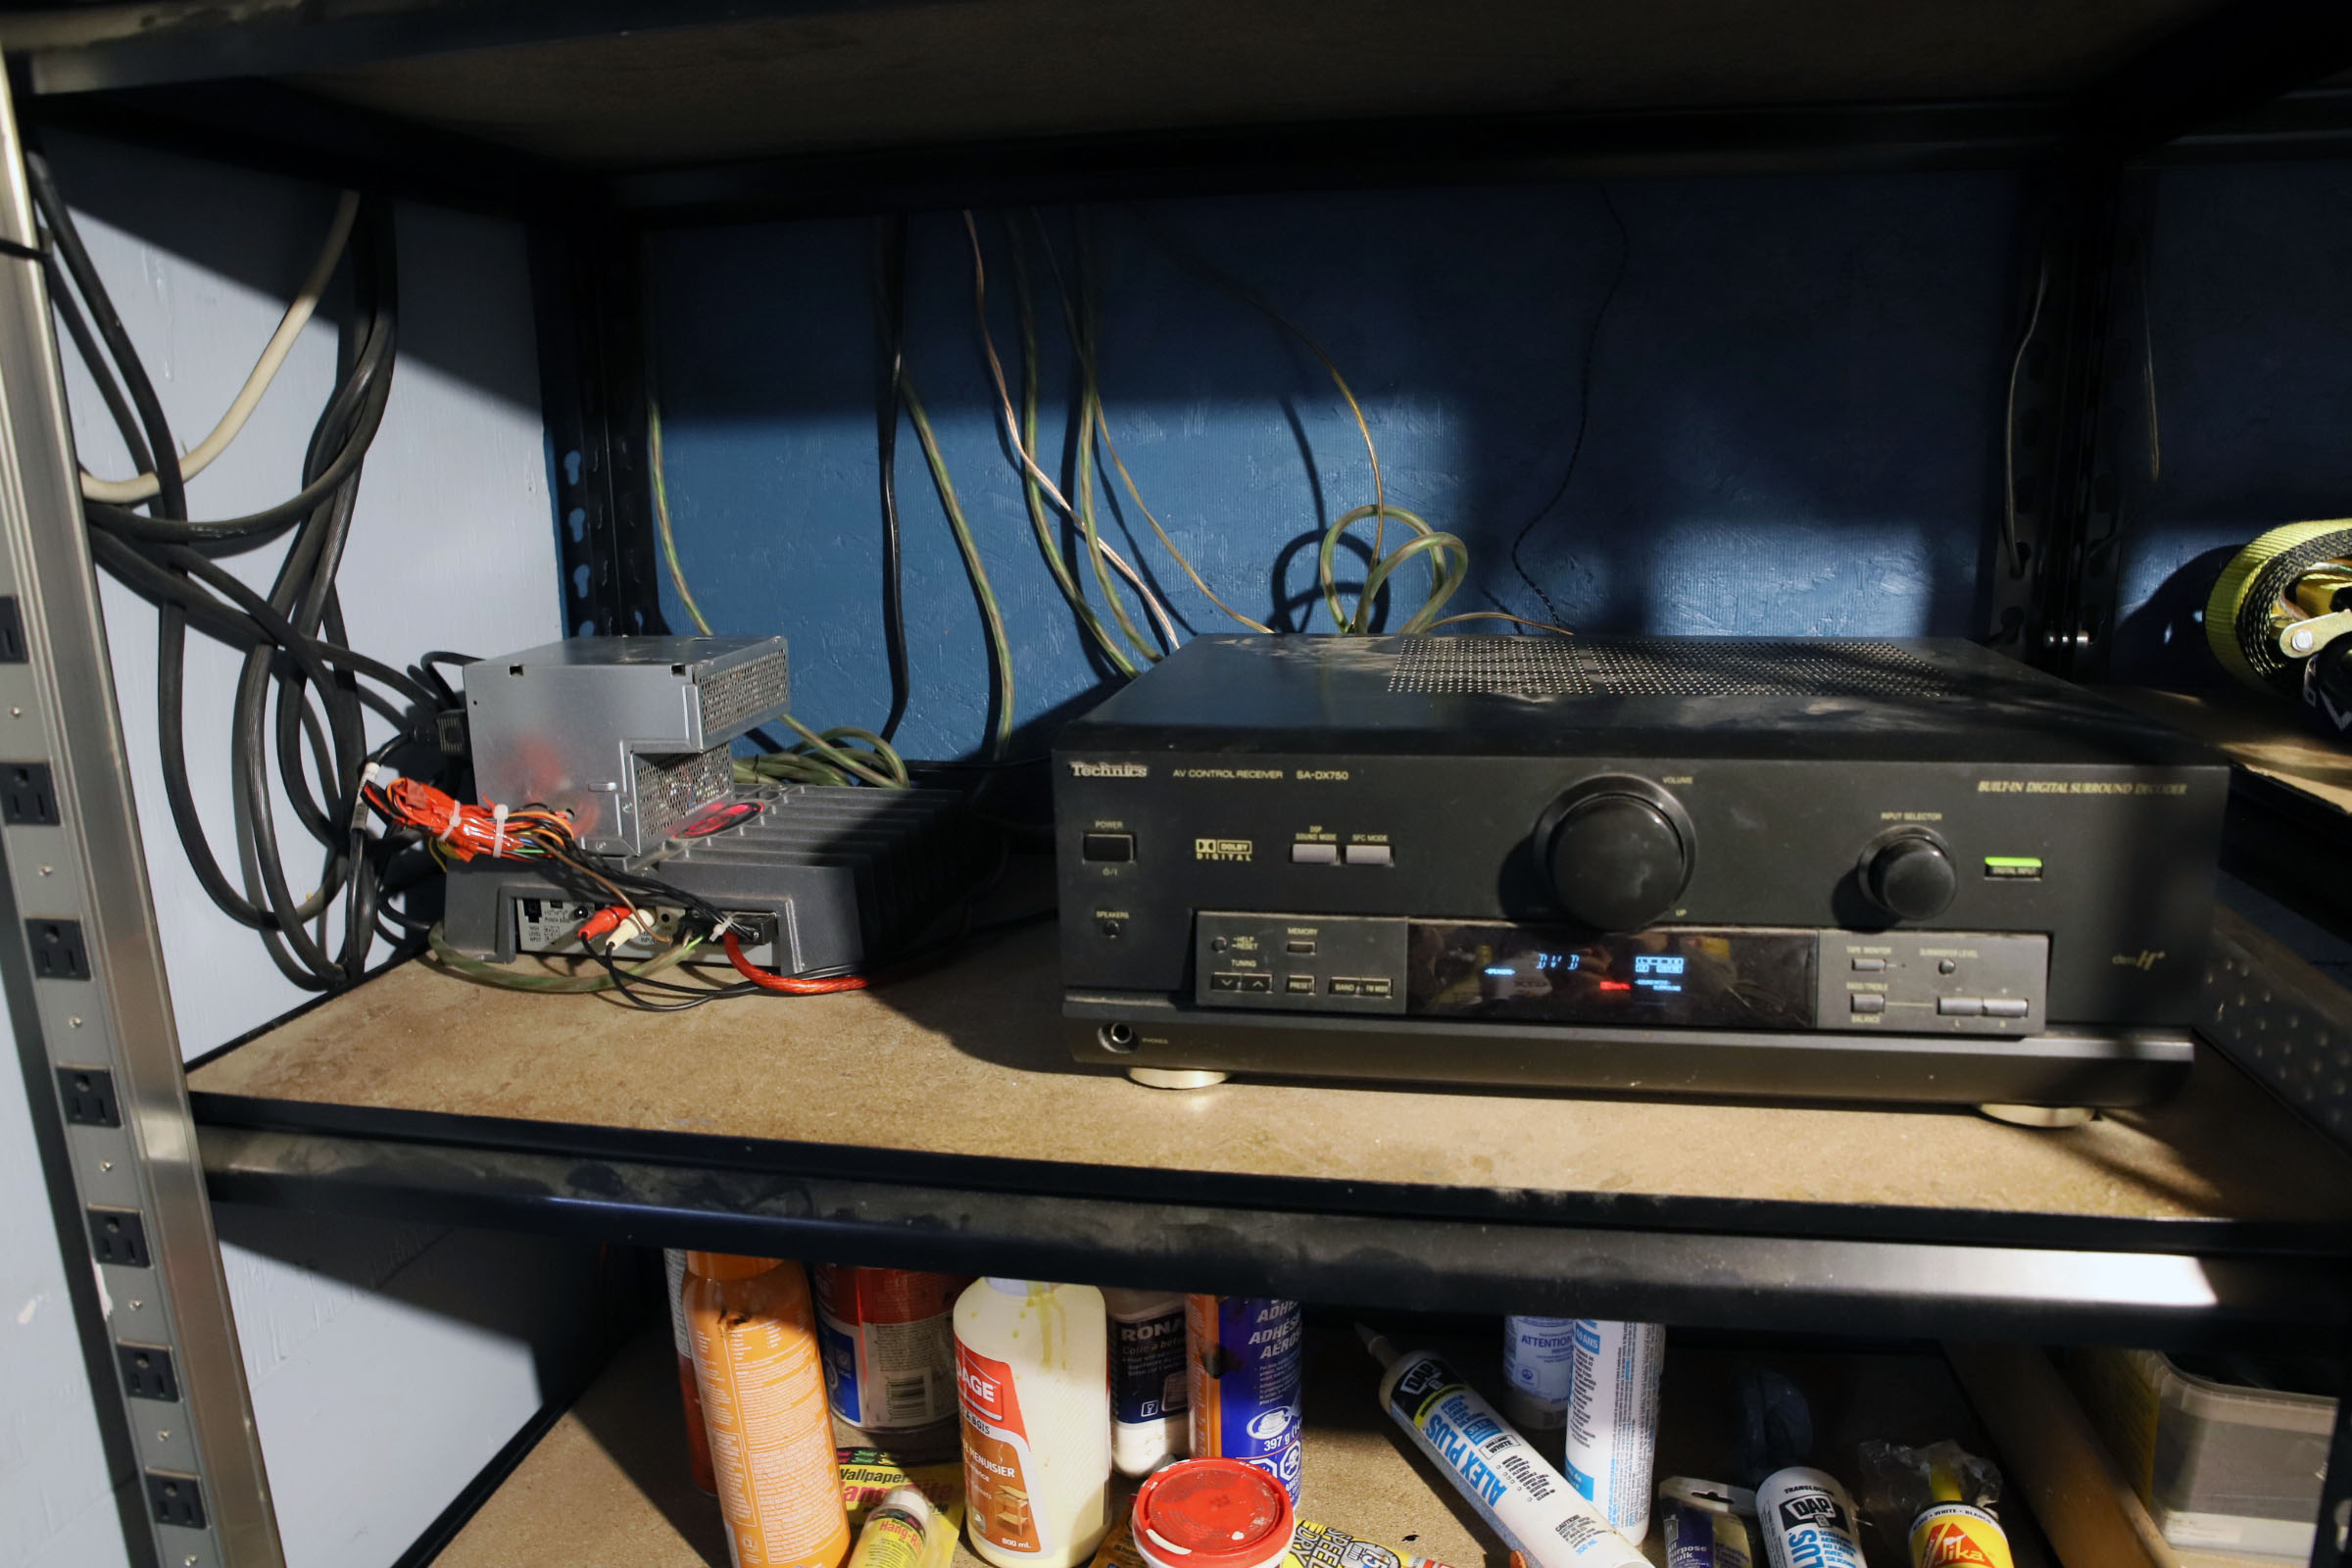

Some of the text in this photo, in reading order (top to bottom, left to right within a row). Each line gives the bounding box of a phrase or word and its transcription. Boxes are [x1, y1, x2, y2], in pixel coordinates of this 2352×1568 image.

[1070, 761, 1148, 777] Technics
[1189, 769, 1234, 778] CONTROL
[1236, 770, 1283, 779] RECEIVER
[1297, 770, 1348, 780] SA-DX750
[1663, 775, 1693, 784] VOLUME
[1978, 781, 2024, 792] BUILT-IN
[2026, 782, 2068, 793] DIGITAL
[2070, 783, 2132, 794] SURROUND
[1096, 910, 1129, 919] SPEAKERS
[1288, 927, 1317, 936] MEMORY
[1263, 1436, 1283, 1451] 397
[1285, 1434, 1291, 1445] g
[1425, 1414, 1468, 1467] PLUS
[1490, 1439, 1513, 1455] WHITE
[1458, 1450, 1507, 1507] ALEX
[1792, 1497, 1831, 1517] DAP
[1002, 1537, 1016, 1545] 800
[1290, 1526, 1321, 1568] DRY
[1936, 1534, 1985, 1565] Sika
